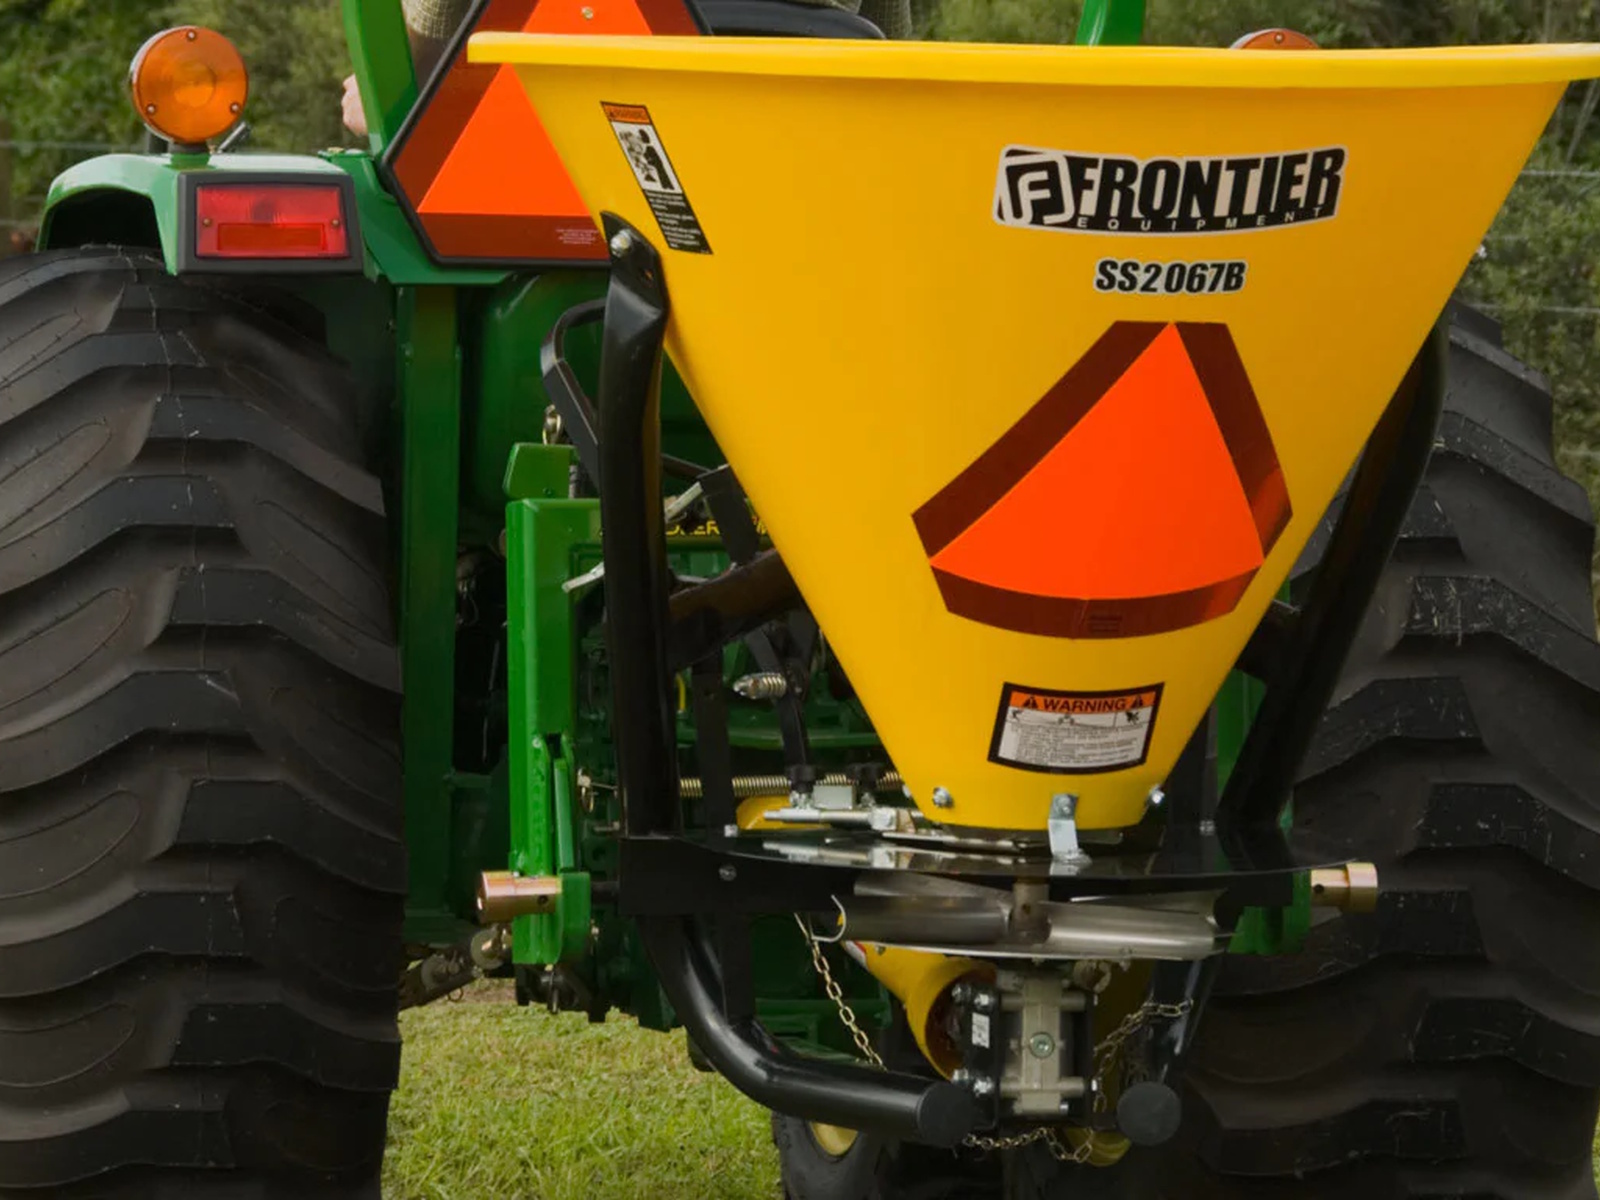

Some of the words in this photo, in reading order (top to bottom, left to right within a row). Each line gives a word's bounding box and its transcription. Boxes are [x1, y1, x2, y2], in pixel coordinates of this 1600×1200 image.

[1064, 148, 1345, 219] FRONTIER
[1077, 207, 1324, 230] EQUIPMENT
[1095, 260, 1246, 292] SS2067B
[1043, 698, 1127, 713] WARNING
